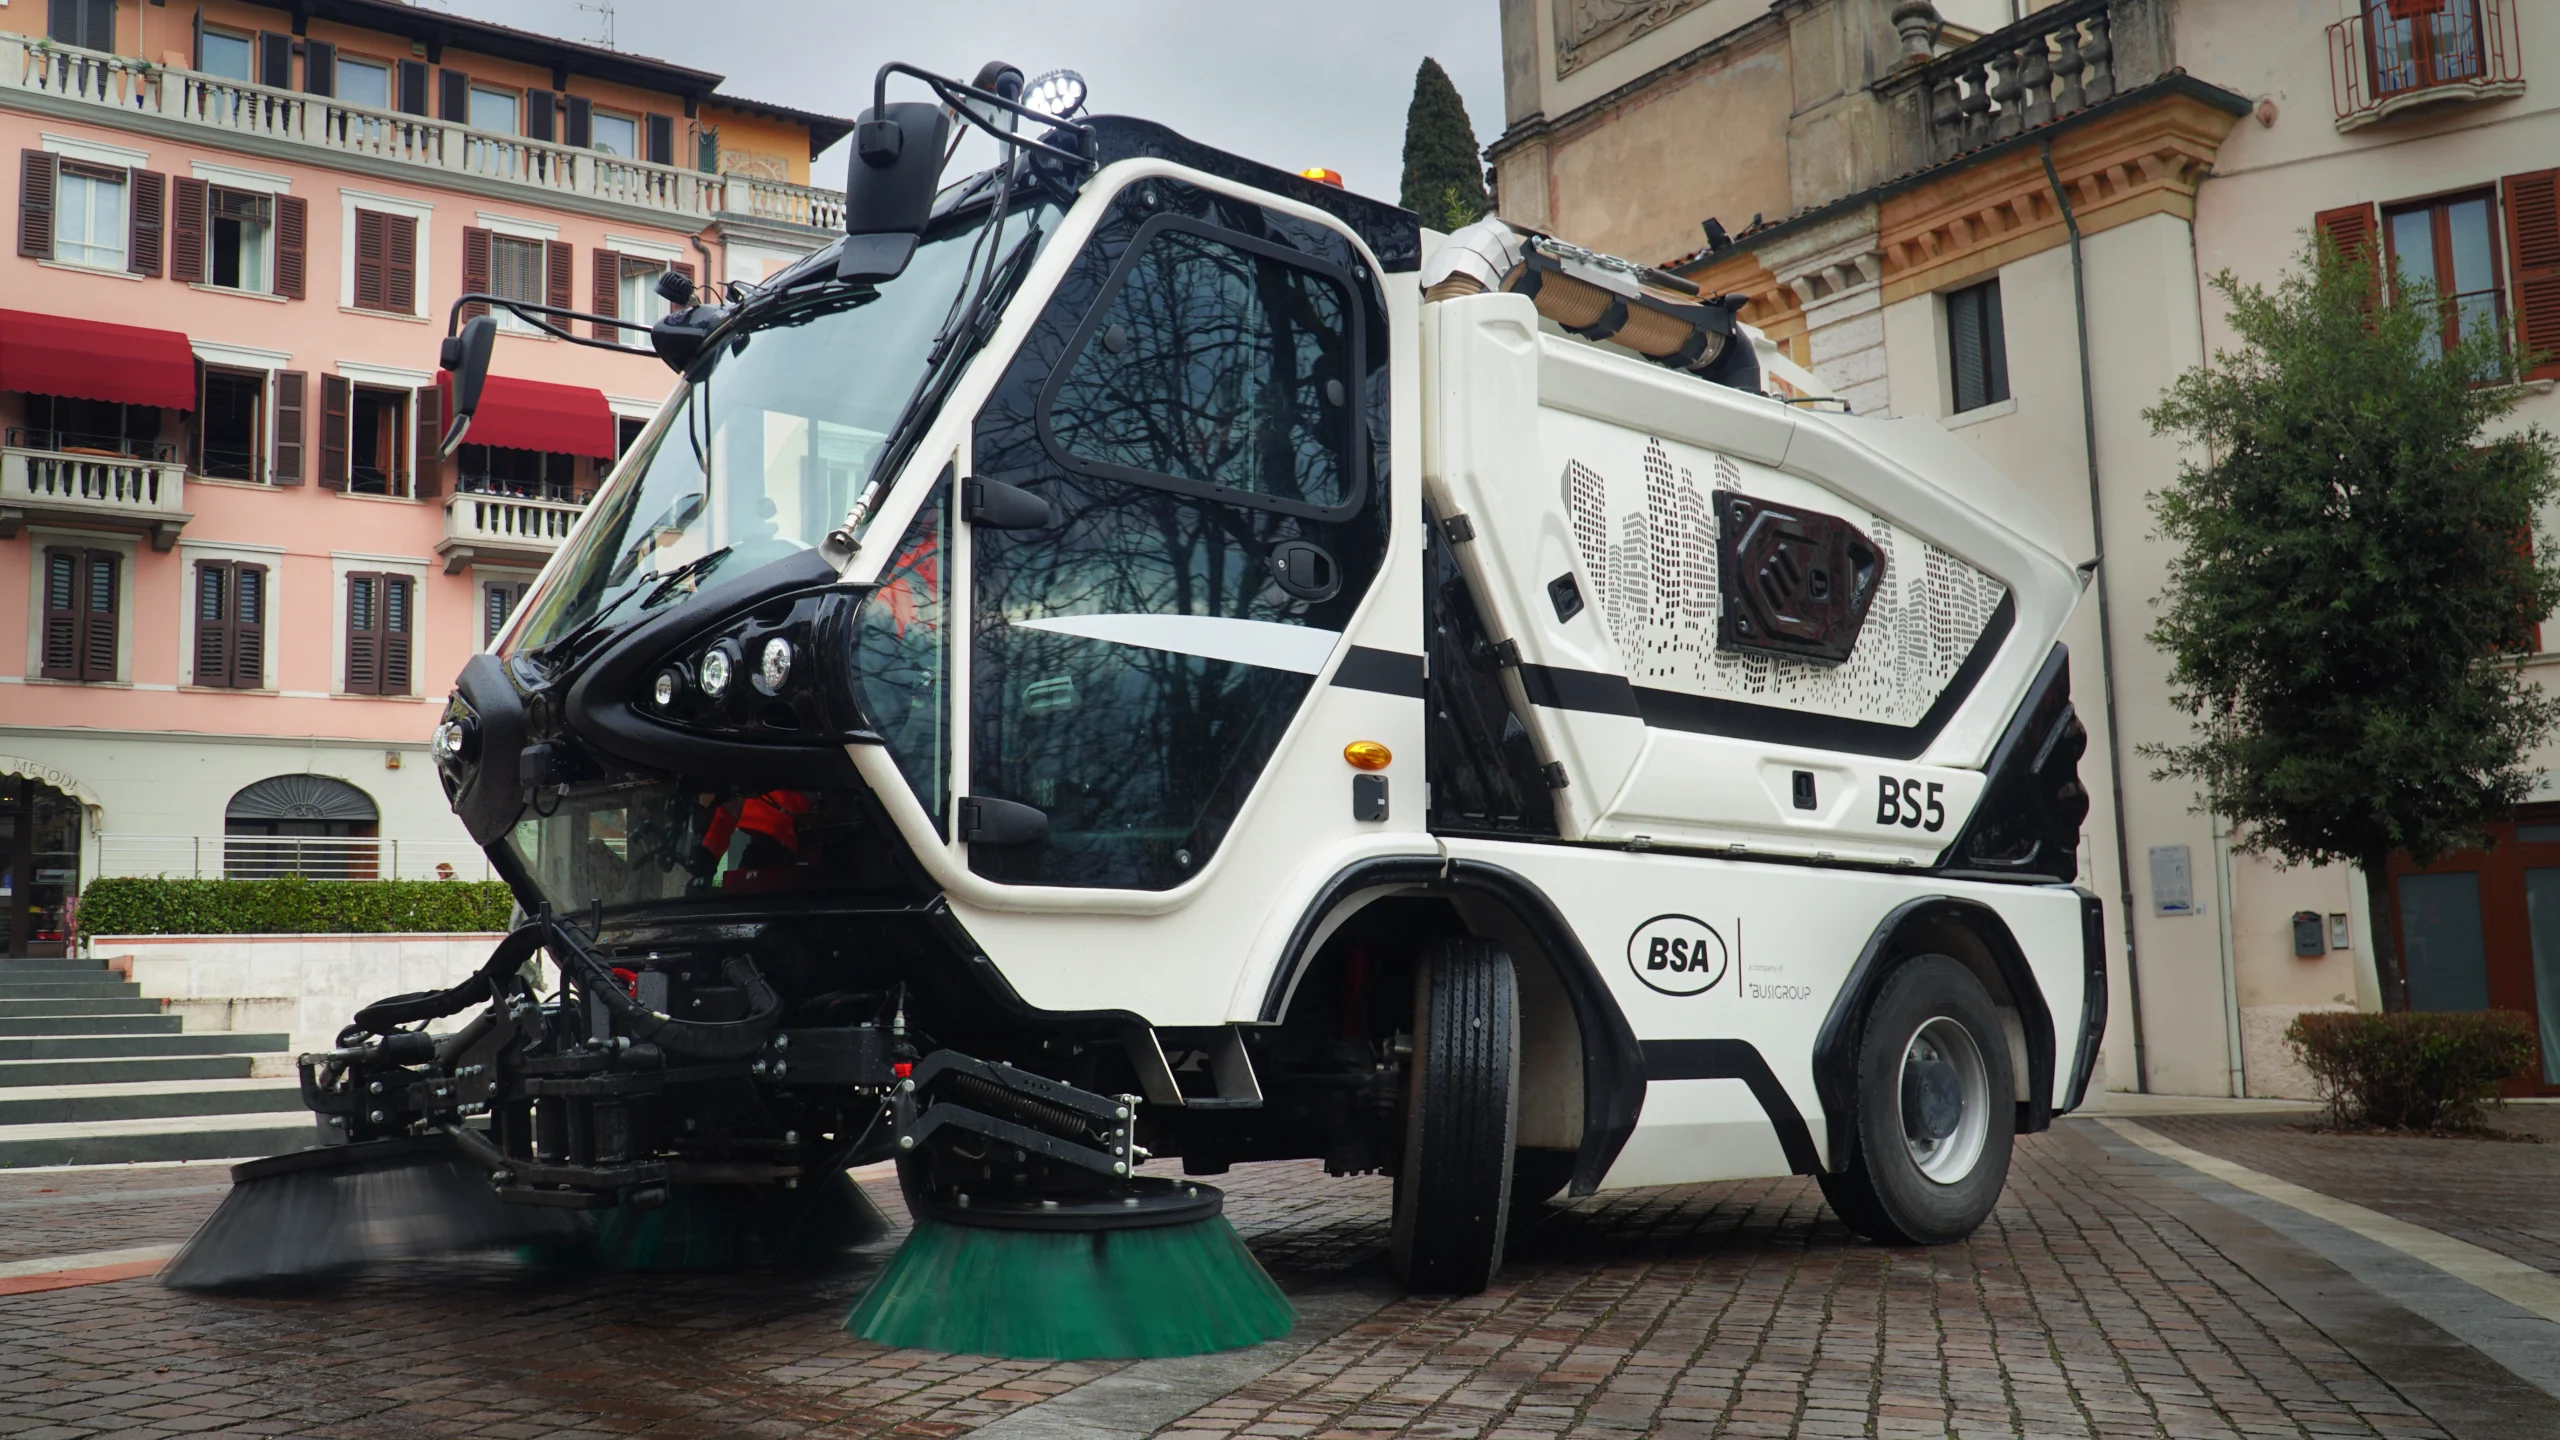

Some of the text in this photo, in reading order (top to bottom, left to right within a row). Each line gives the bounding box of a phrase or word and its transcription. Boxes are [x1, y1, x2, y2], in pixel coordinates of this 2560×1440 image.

[1876, 774, 1945, 832] BS5
[1647, 936, 1709, 973] BSA
[1751, 984, 1811, 1000] BUSIGROUP
